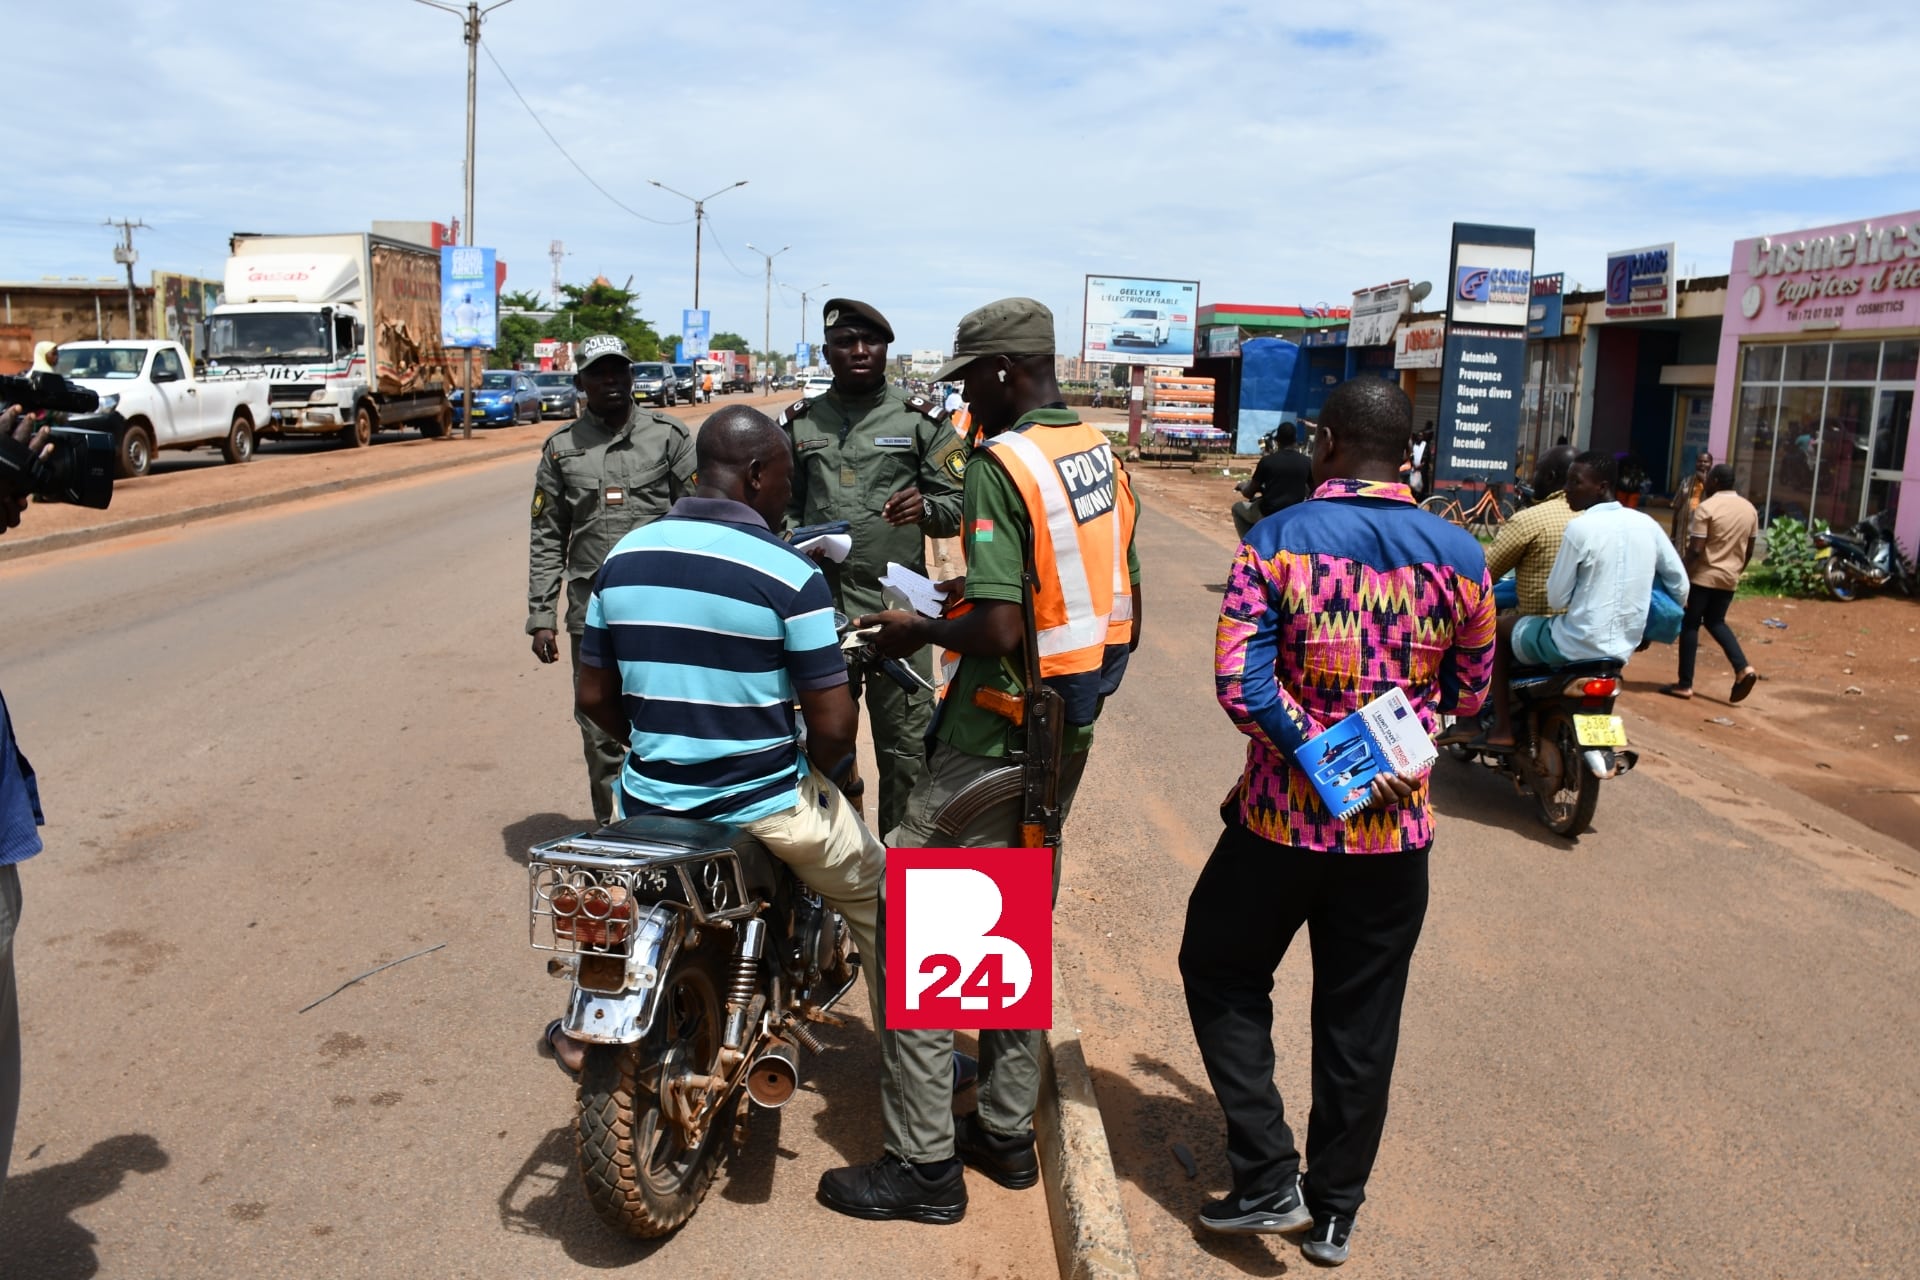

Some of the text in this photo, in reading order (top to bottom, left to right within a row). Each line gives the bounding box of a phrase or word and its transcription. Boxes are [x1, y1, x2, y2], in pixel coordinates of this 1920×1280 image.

[1749, 223, 1920, 278] Cosmetics
[1490, 268, 1530, 285] CORIS
[1120, 288, 1161, 297] GEELY EX5
[1775, 275, 1862, 307] Caprices
[1154, 297, 1179, 305] FIABLE
[1856, 301, 1904, 315] COSMETICS
[585, 337, 621, 352] POLICE
[1461, 350, 1498, 364] Automobile
[1459, 367, 1502, 383] Prevoyance
[1457, 384, 1512, 399] Risques divers
[1456, 402, 1479, 415] Santé
[1452, 436, 1486, 449] Incendie
[1451, 455, 1508, 470] Bancassurance
